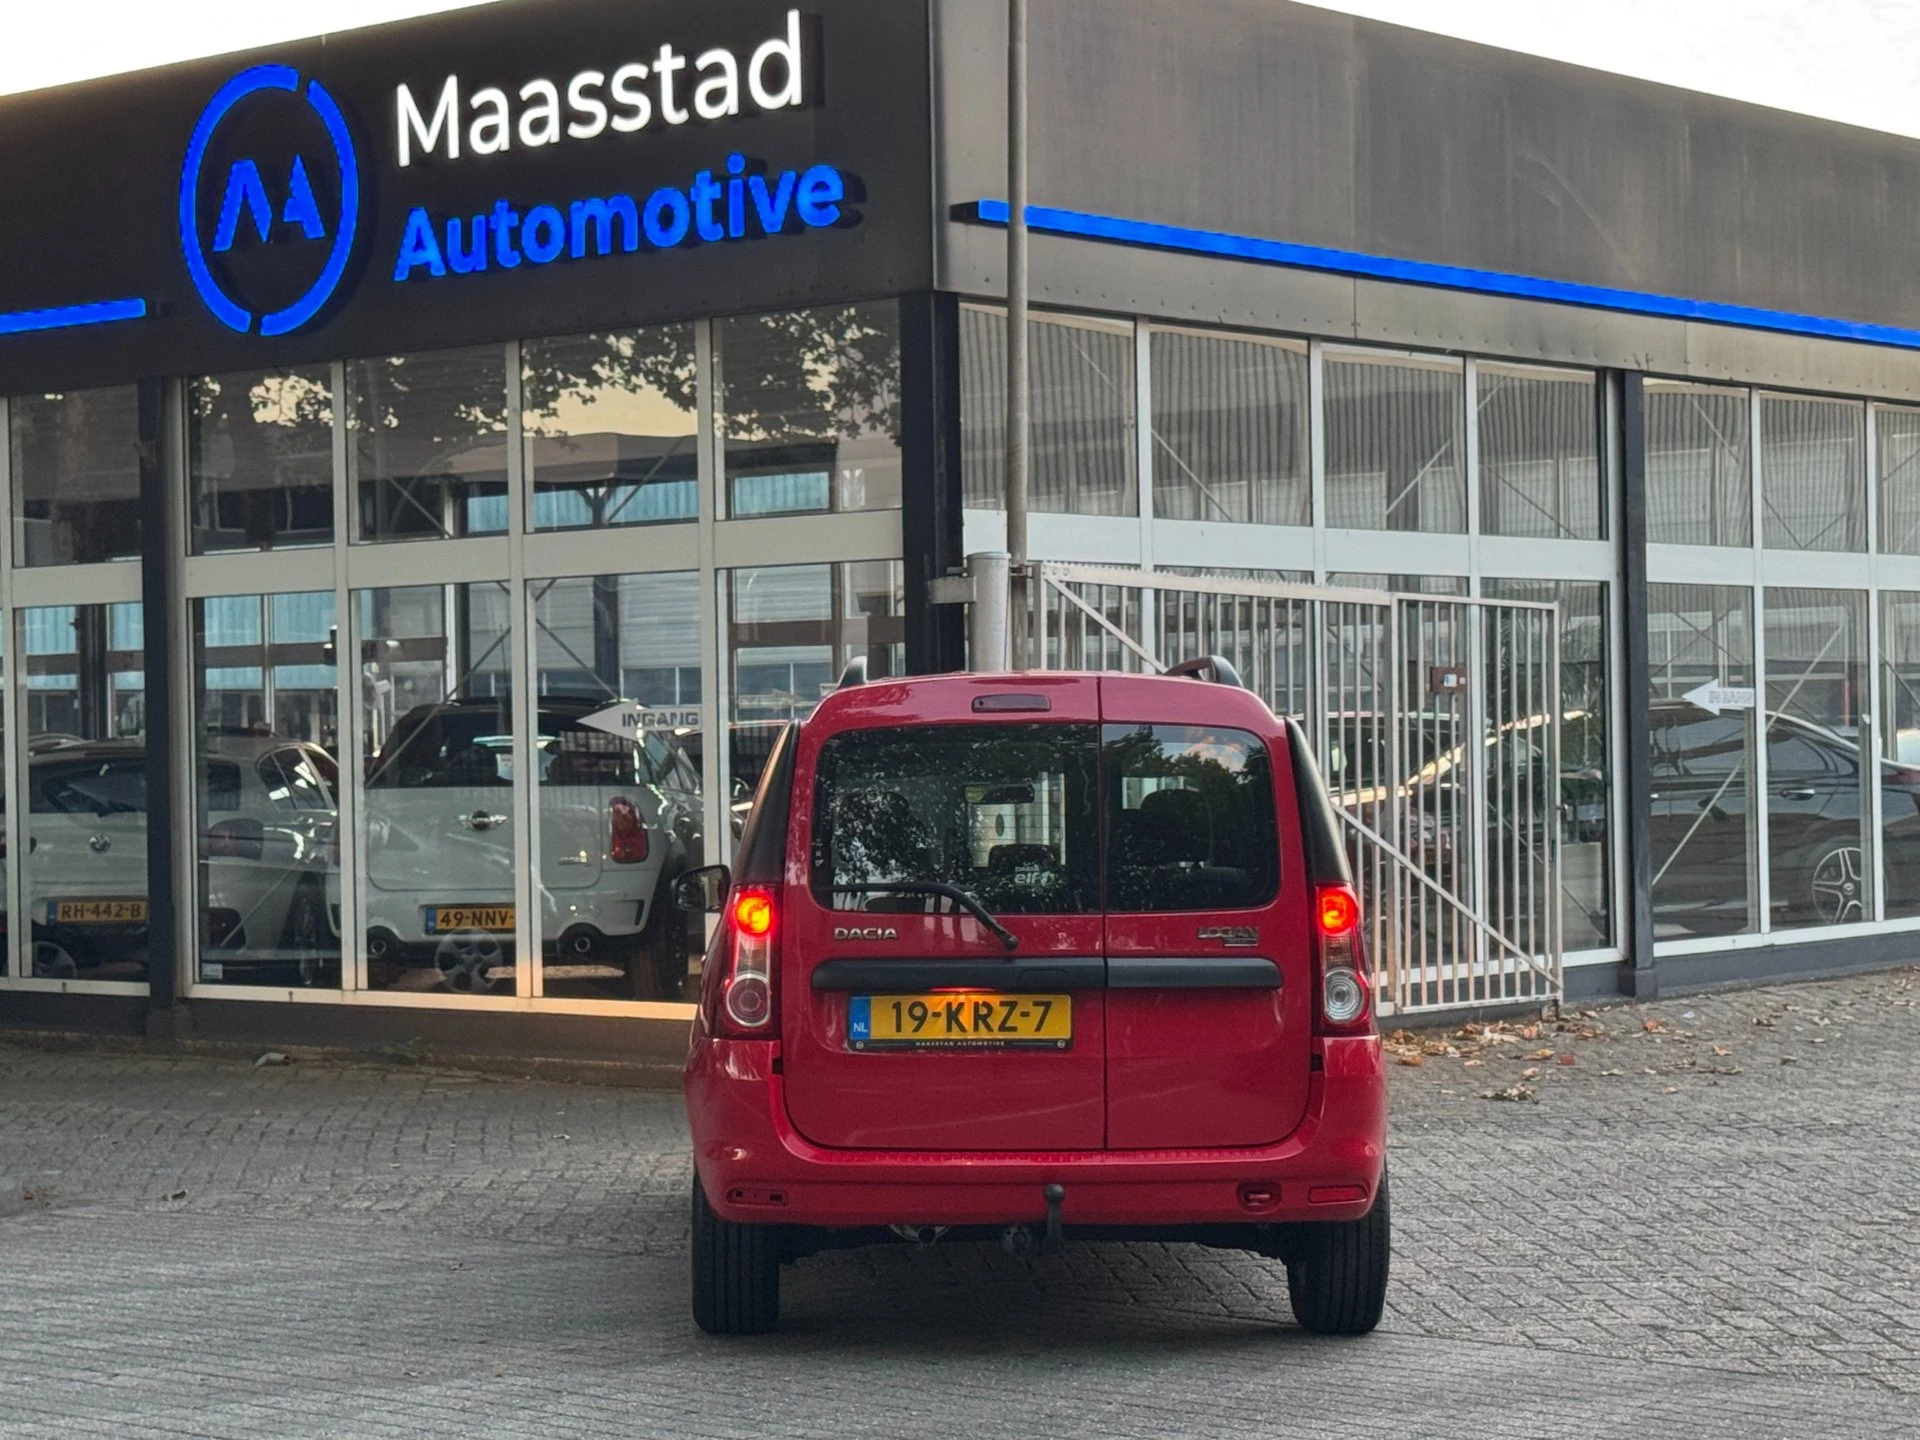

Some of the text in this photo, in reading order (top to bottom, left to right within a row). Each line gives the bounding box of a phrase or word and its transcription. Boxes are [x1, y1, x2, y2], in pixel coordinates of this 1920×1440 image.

[396, 8, 802, 168] Maasstad
[393, 152, 845, 282] Automotive
[621, 711, 699, 728] INGANG
[61, 903, 141, 919] RH-442-B
[440, 911, 515, 927] 49-NNV-
[834, 927, 898, 940] DACIA
[853, 1000, 1053, 1033] NL 19-KRZ-7
